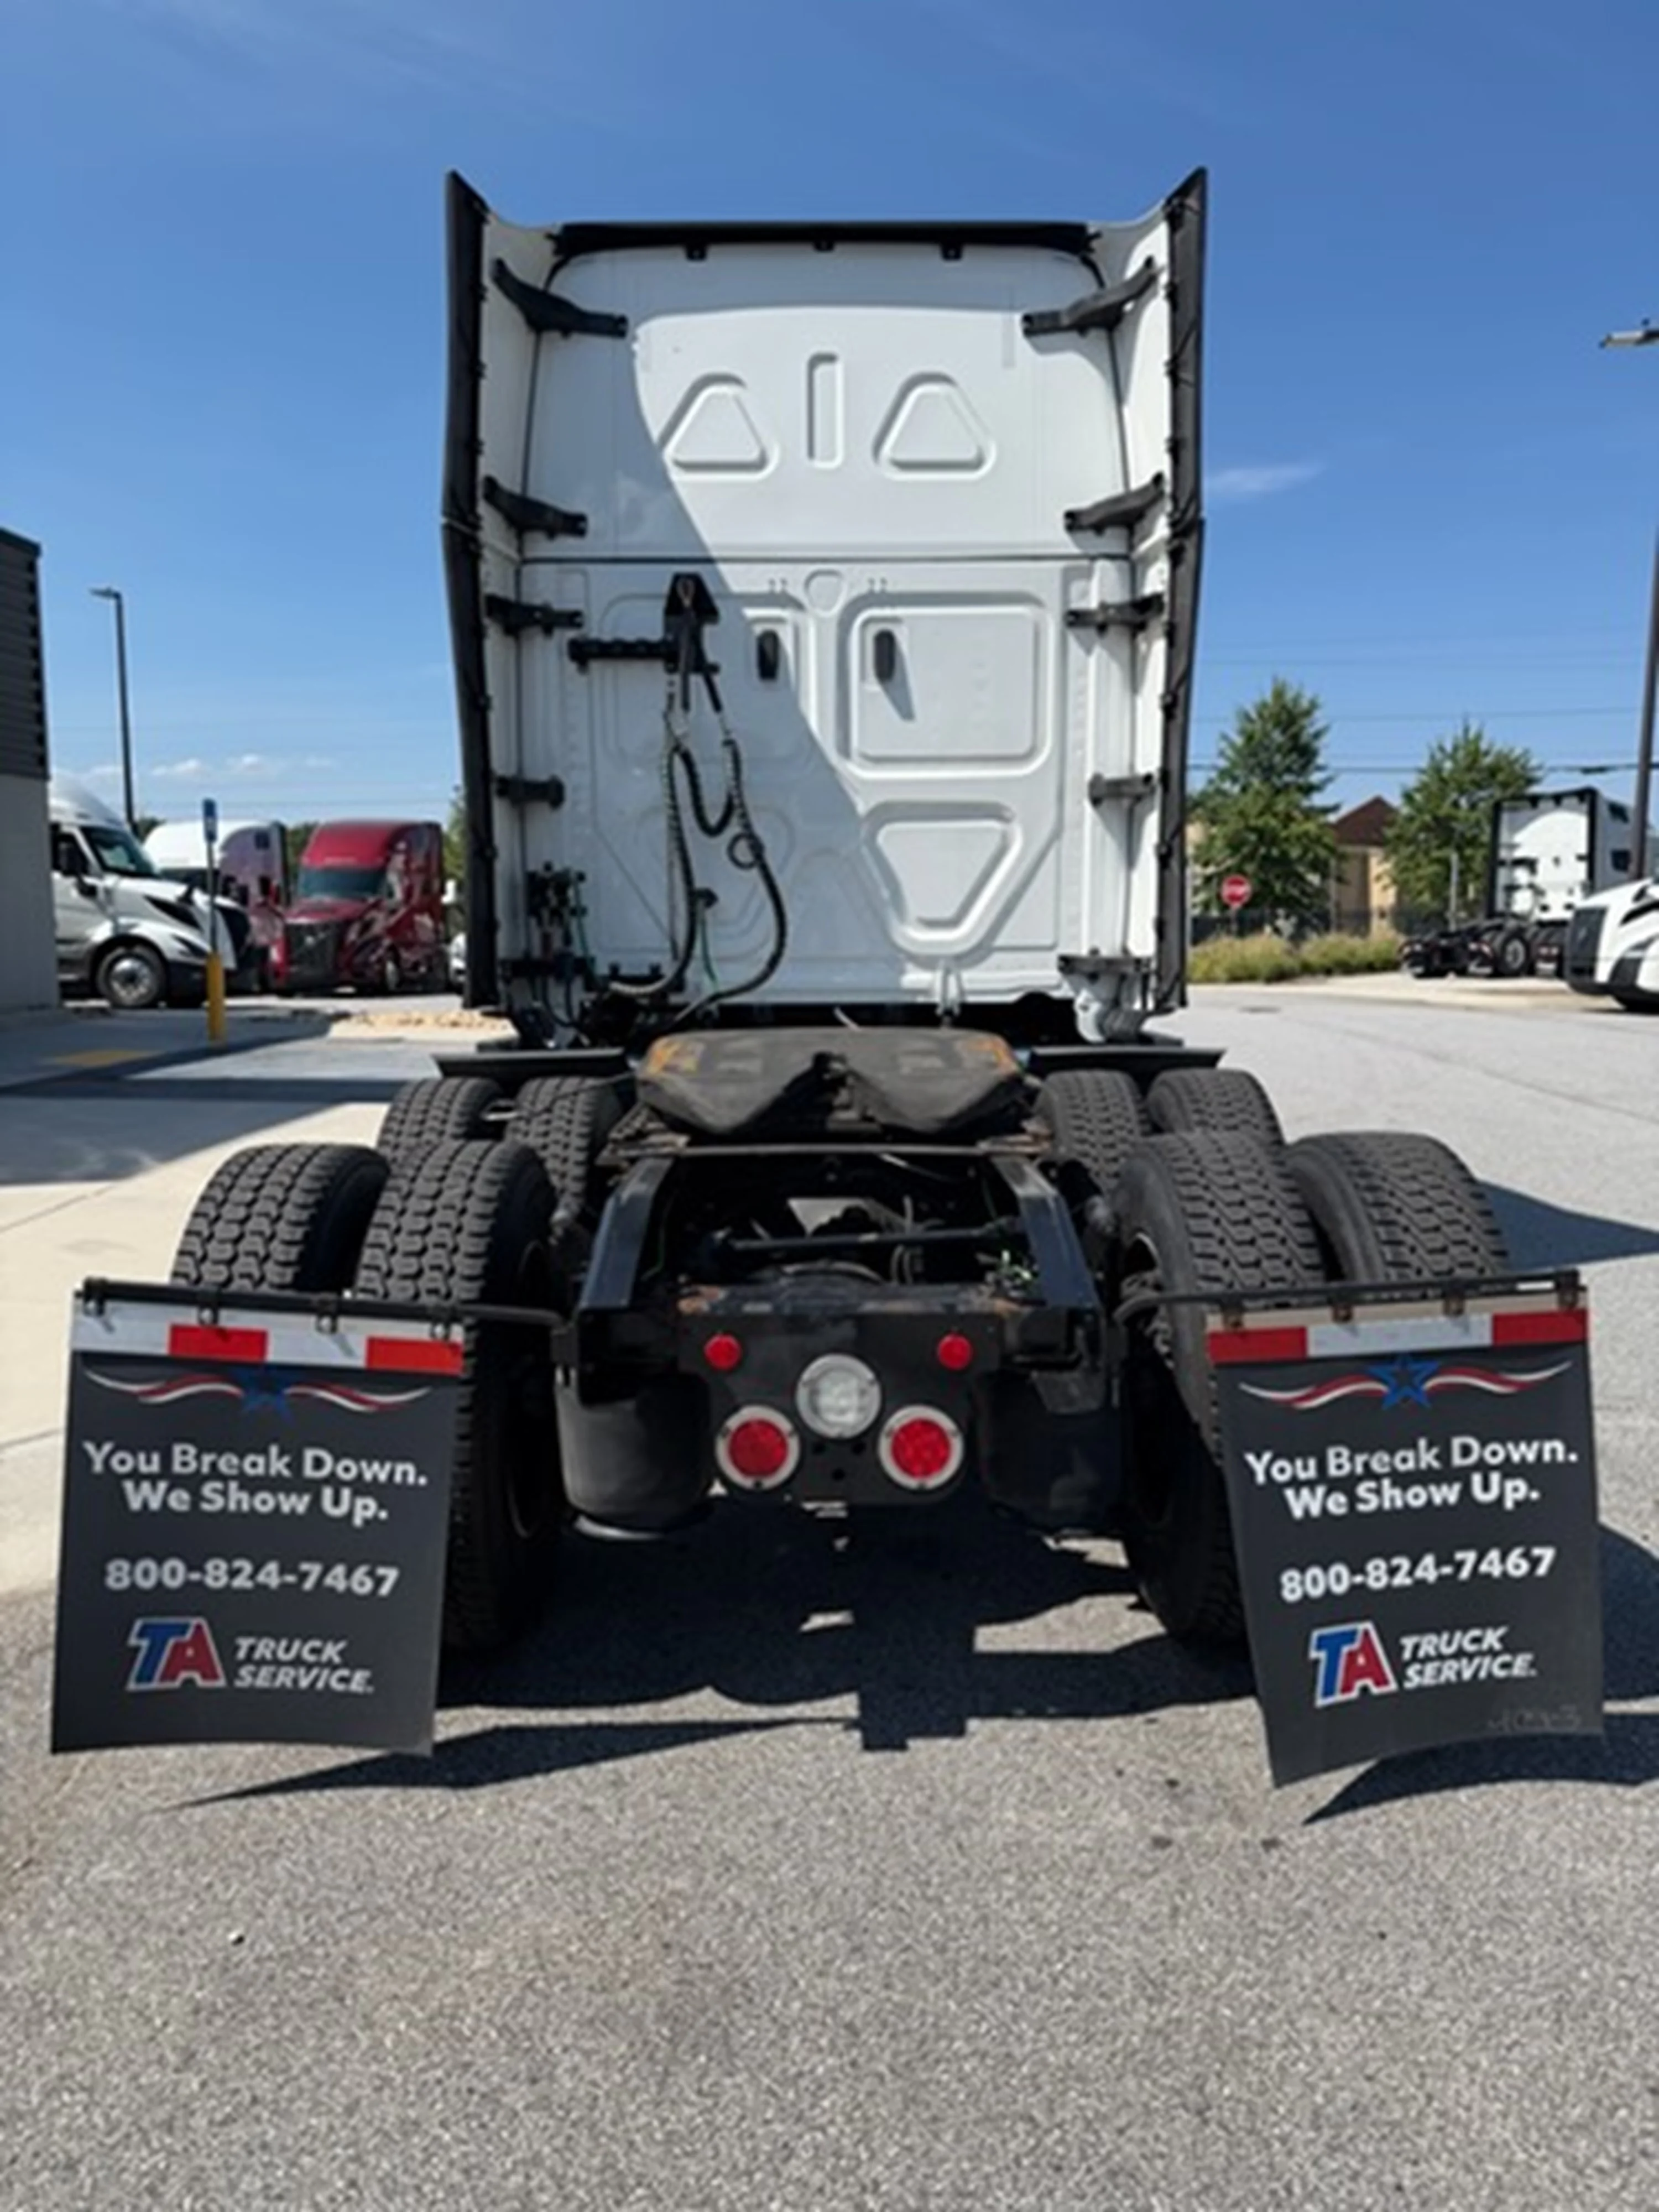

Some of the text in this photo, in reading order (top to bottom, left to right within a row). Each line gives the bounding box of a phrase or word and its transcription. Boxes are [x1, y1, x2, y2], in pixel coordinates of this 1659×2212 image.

[83, 1441, 428, 1486] You Break Down.
[1244, 1435, 1579, 1485] You Break Down.
[123, 1480, 389, 1528] We Show Up.
[1284, 1470, 1541, 1520] We Show Up.
[106, 1558, 400, 1597] 800-824-7467
[1280, 1546, 1557, 1603] 800-824-7467
[126, 1616, 227, 1691] TA
[236, 1637, 347, 1665] TRUCK
[1308, 1620, 1399, 1708] TA
[1400, 1626, 1509, 1661] TRUCK
